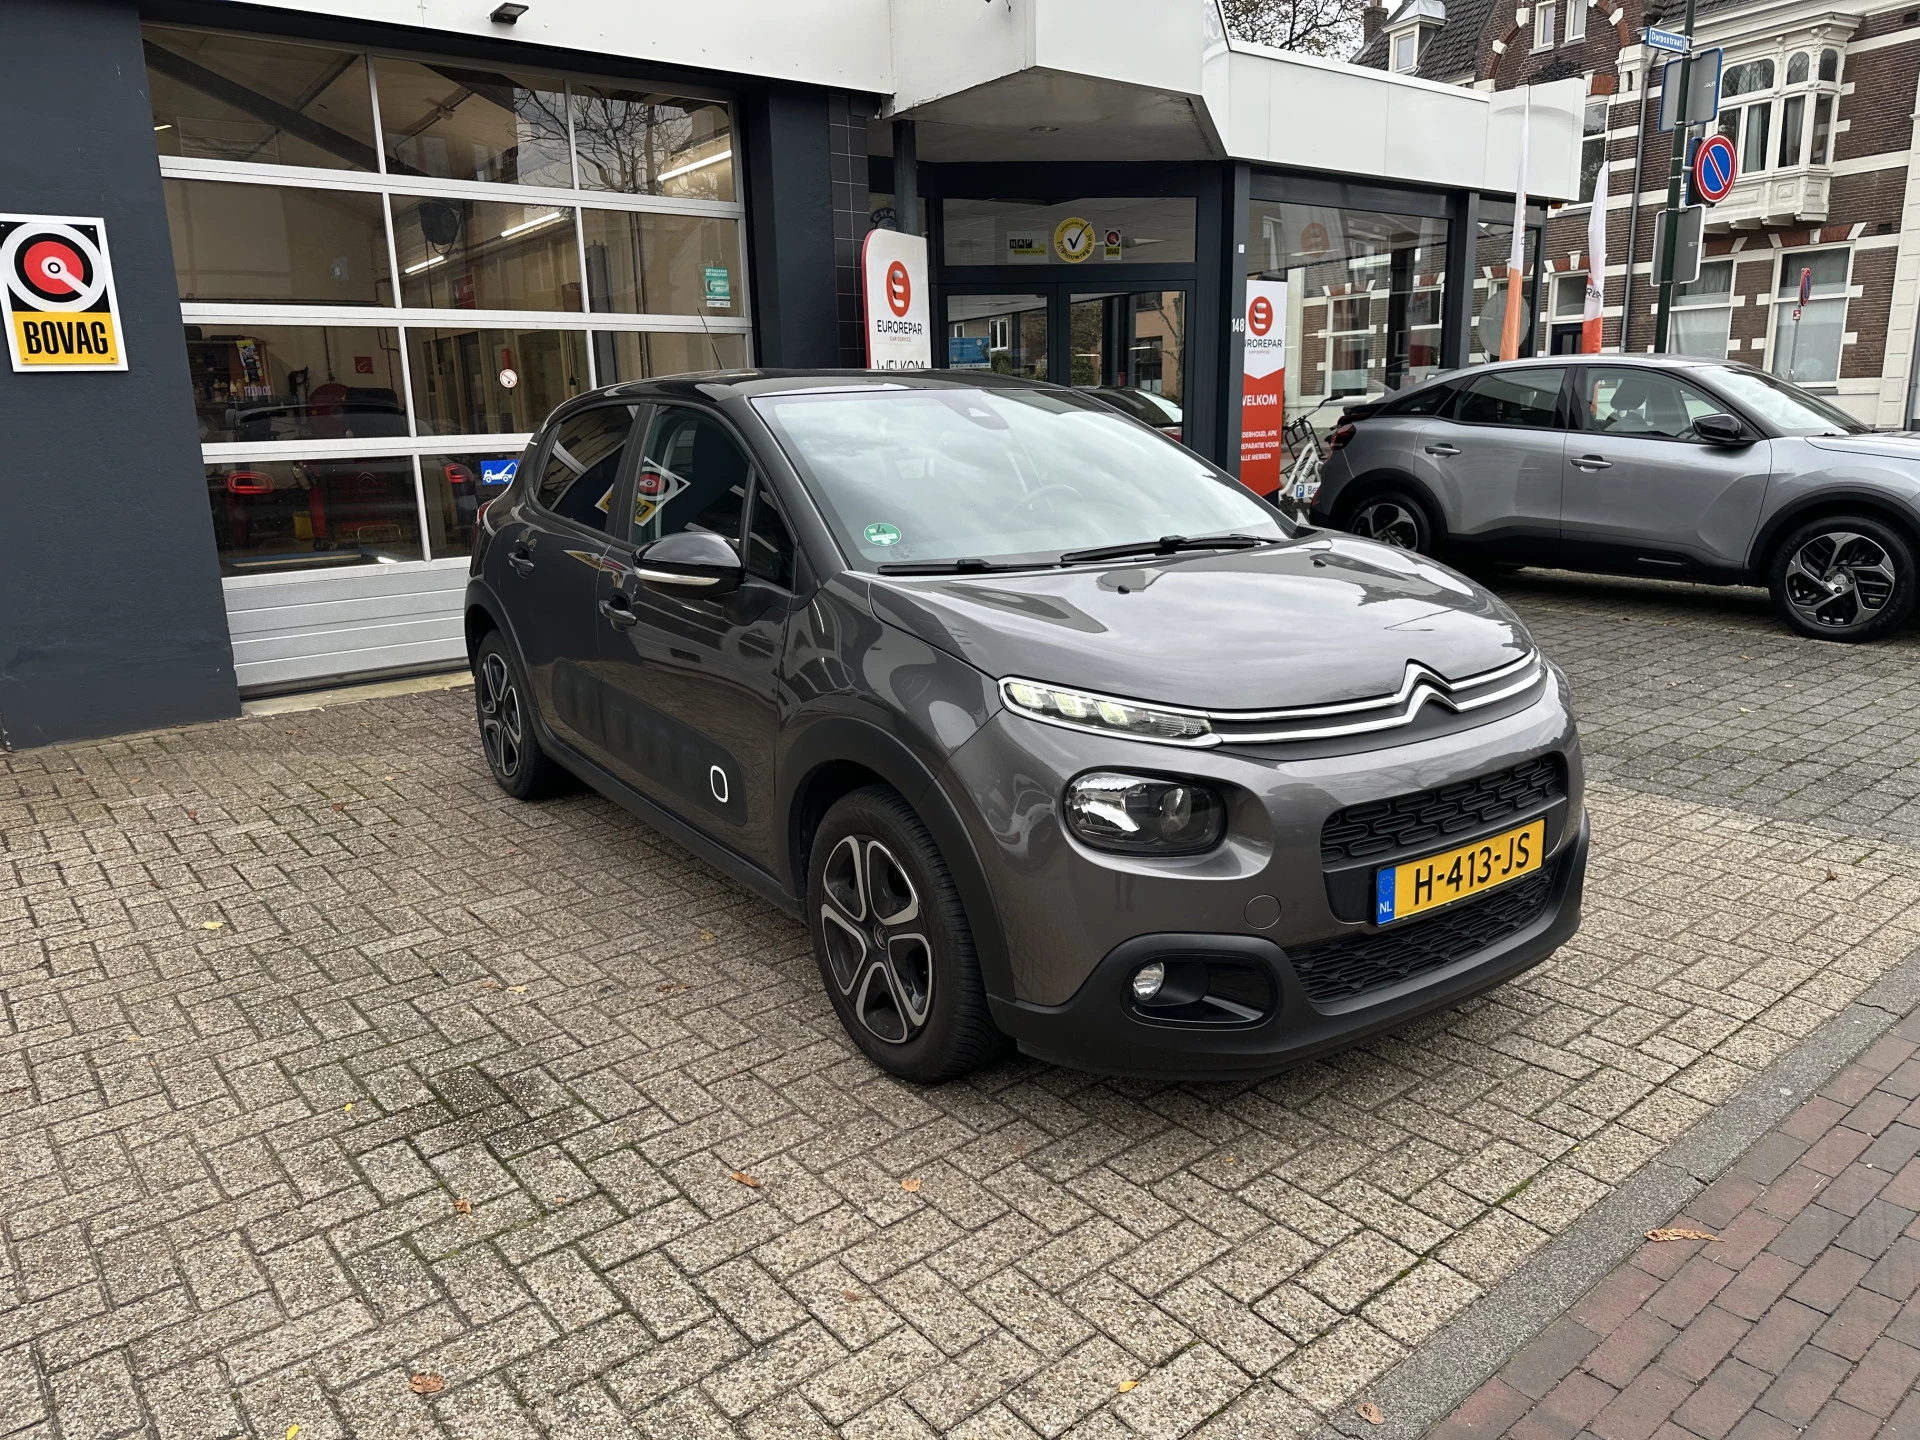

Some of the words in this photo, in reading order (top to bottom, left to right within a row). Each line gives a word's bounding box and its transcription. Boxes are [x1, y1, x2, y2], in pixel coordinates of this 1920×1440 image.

[1651, 31, 1683, 47] Dorpsstraat
[1010, 239, 1032, 248] NAP
[877, 320, 923, 335] EUROREPAR
[1232, 318, 1245, 332] 148
[22, 321, 109, 354] BOVAG
[1245, 339, 1283, 348] ROREPAR
[1414, 832, 1530, 906] H-413-JS
[1379, 901, 1393, 914] NL
